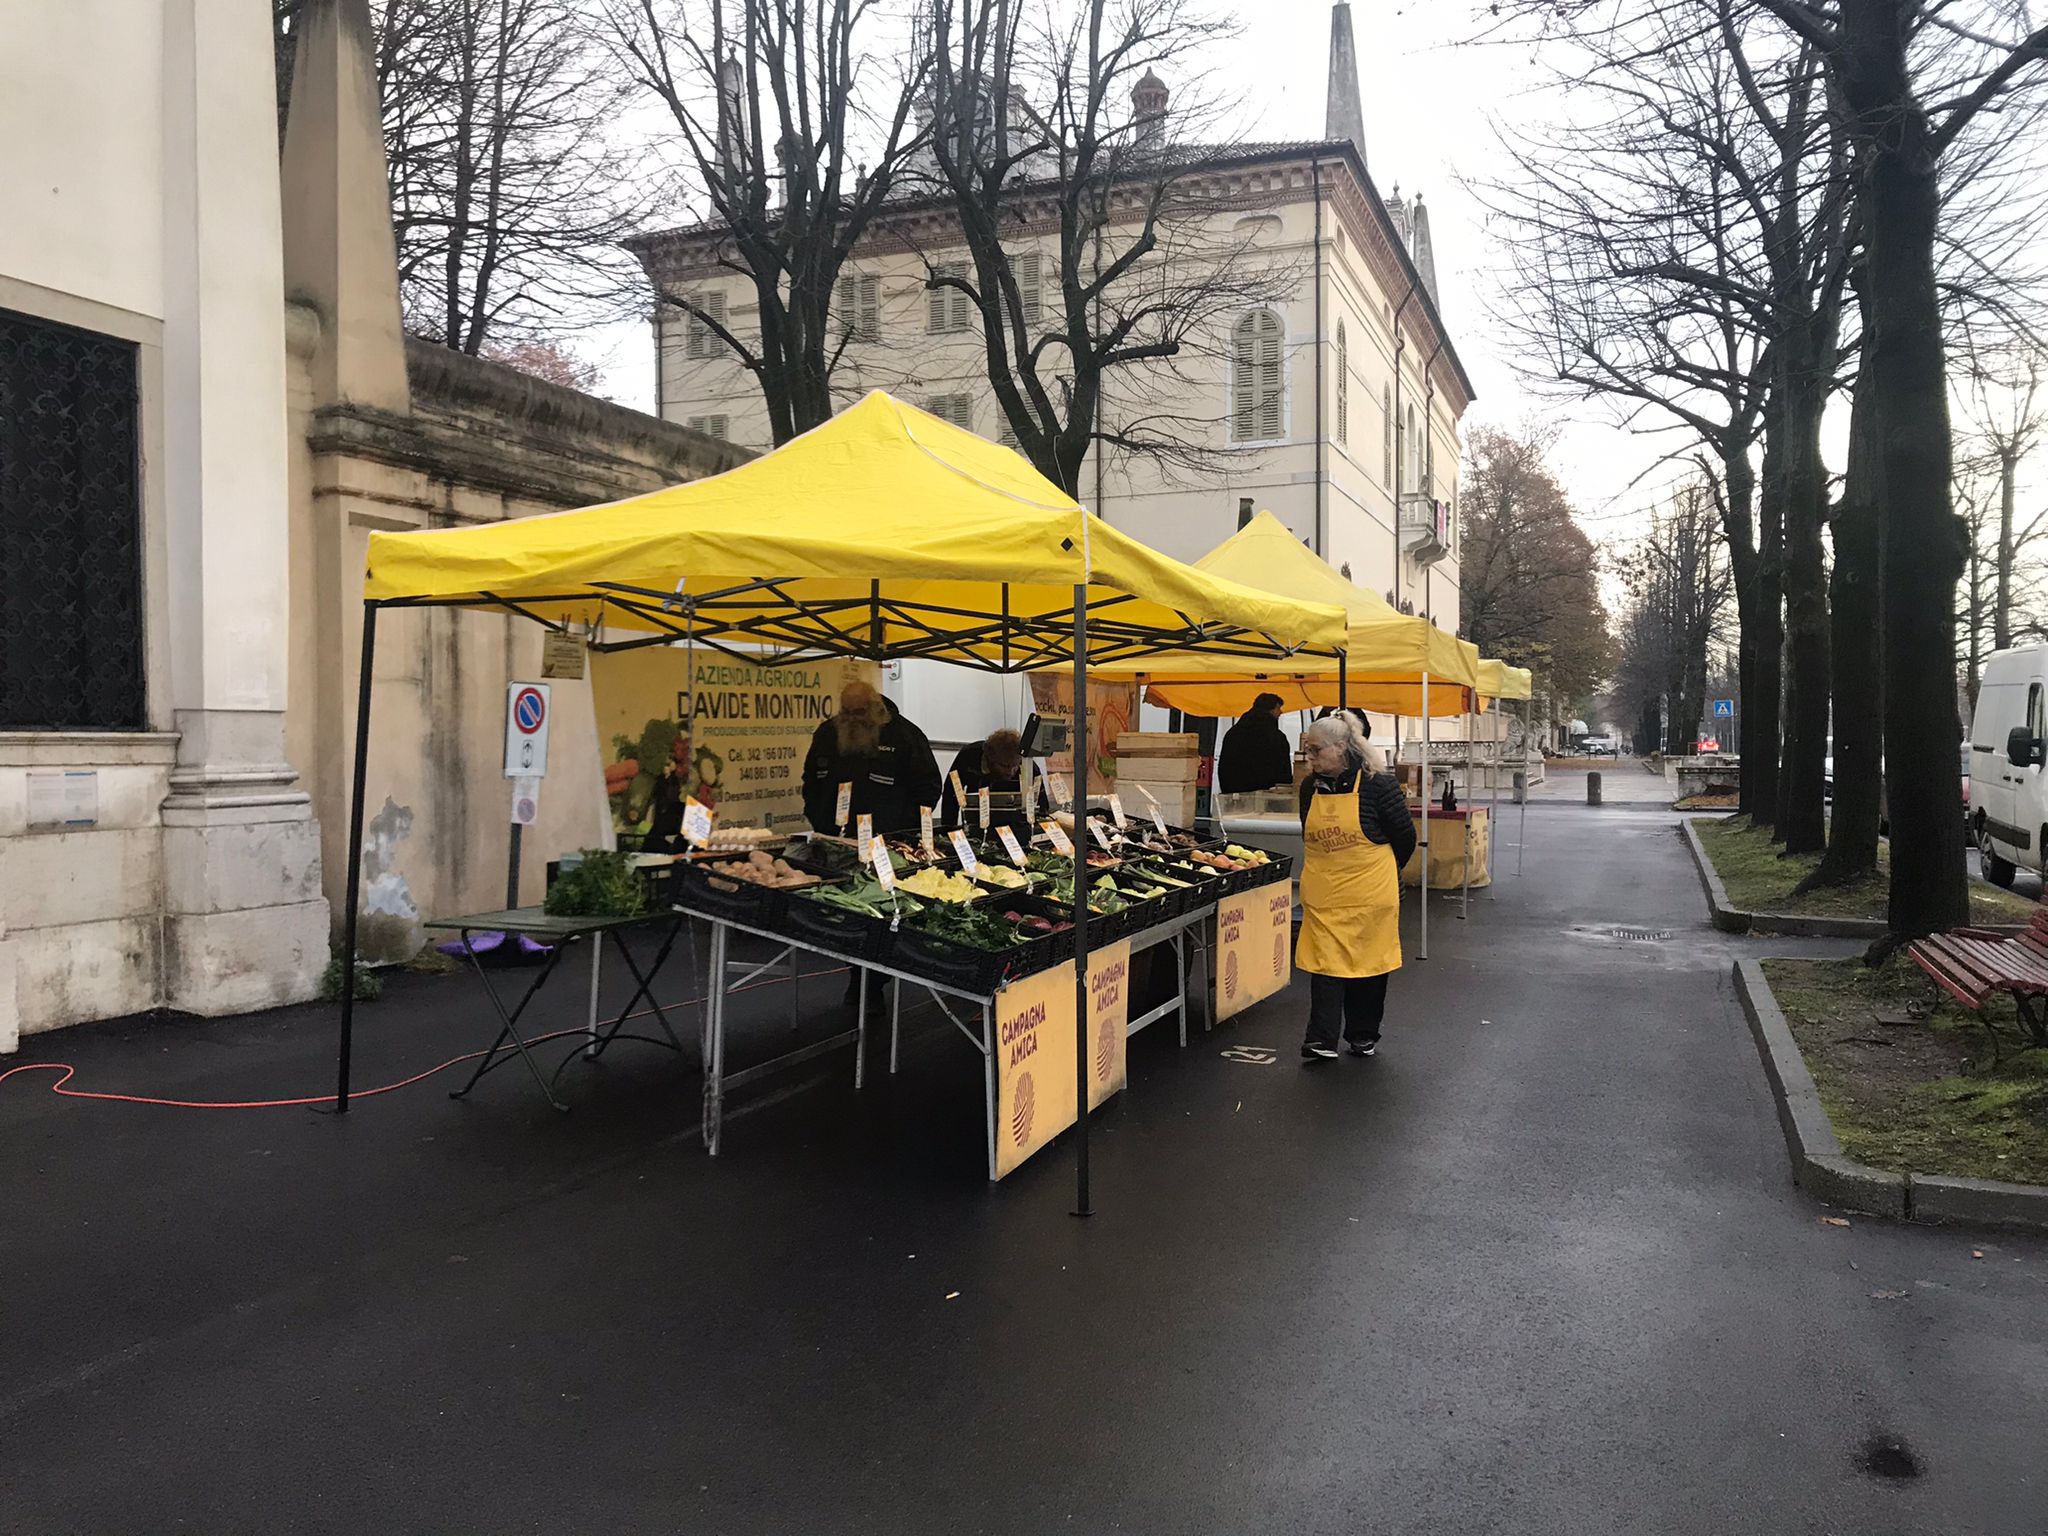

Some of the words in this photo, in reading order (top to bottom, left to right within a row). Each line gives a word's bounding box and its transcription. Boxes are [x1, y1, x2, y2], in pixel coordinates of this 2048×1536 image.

[696, 665, 752, 686] AZIENDA
[755, 669, 821, 689] AGRICOLA
[677, 691, 750, 719] DAVIDE
[755, 693, 833, 720] MONTINO
[1269, 895, 1290, 912] CAMPAGNA
[1220, 907, 1244, 928] CAMPAGNA
[1273, 911, 1286, 927] AMICA
[1224, 926, 1240, 945] AMICA
[1092, 960, 1125, 993] CAMPAGNA
[1096, 984, 1118, 1014] AMICA
[1002, 1000, 1045, 1046] CAMPAGNA
[1010, 1031, 1037, 1068] AMICA
